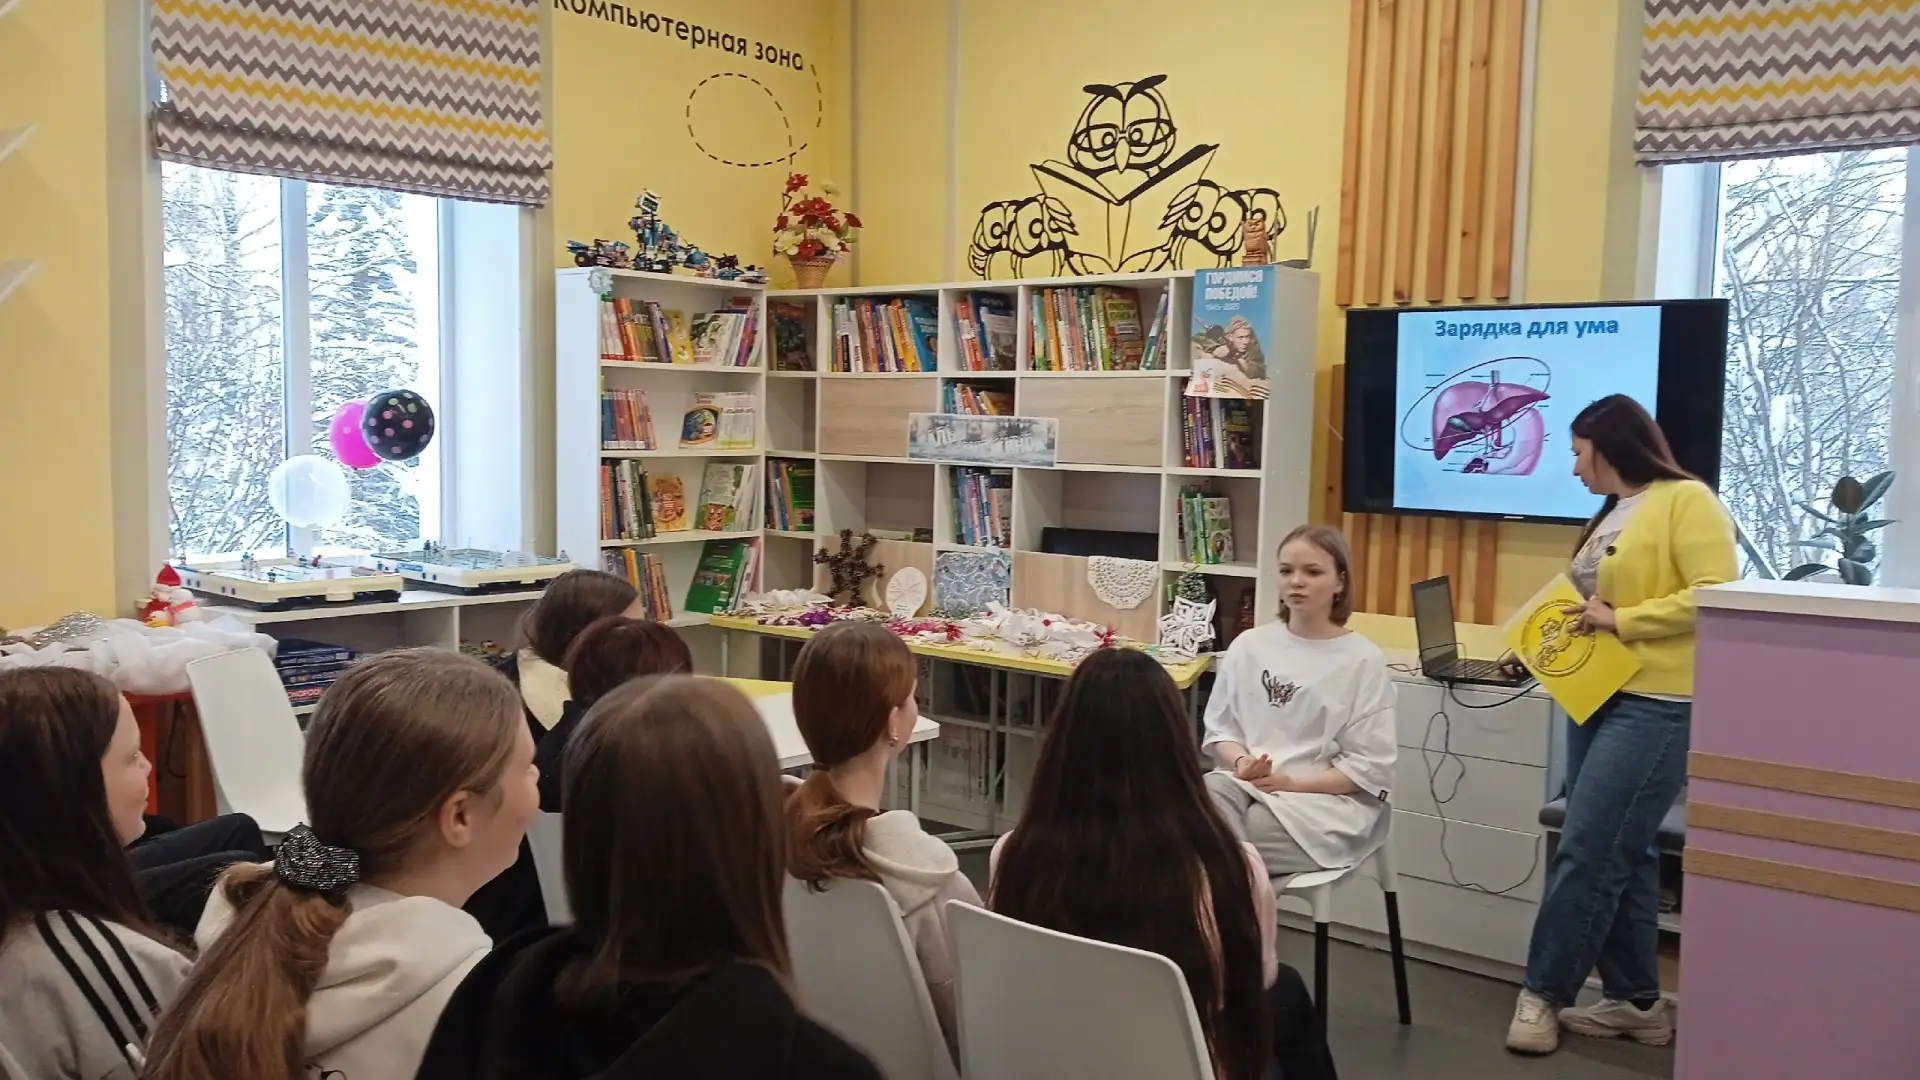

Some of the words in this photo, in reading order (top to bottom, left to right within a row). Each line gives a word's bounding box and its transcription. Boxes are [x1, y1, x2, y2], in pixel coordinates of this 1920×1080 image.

[754, 41, 804, 71] зона
[1435, 319, 1522, 340] Зарядка
[1527, 319, 1568, 339] для
[1574, 319, 1619, 339] ума
